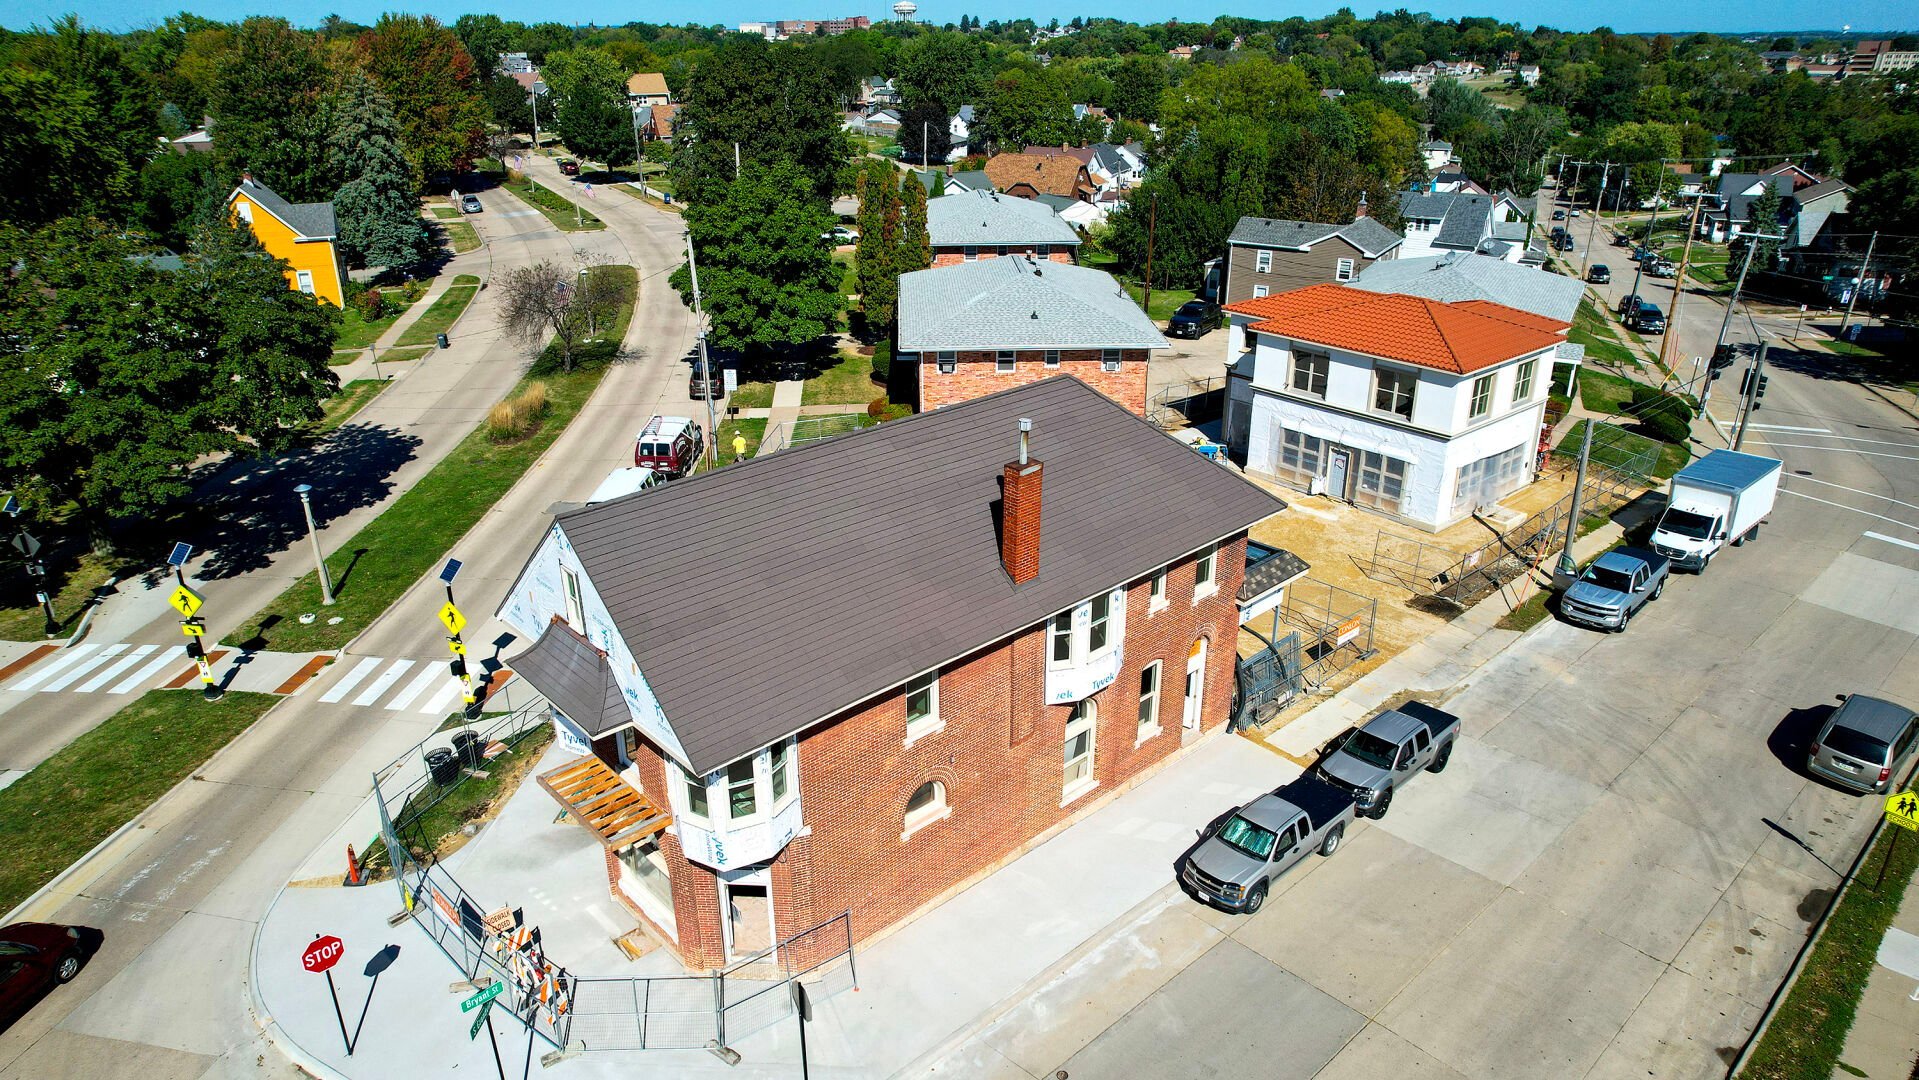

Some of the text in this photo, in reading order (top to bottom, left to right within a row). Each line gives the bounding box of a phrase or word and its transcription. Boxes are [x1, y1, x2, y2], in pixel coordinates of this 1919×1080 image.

[1092, 672, 1115, 690] Tyvek
[1888, 814, 1914, 829] SCHOOL
[492, 919, 511, 933] CLOSED
[305, 941, 340, 968] STOP
[465, 990, 491, 1009] Bryant
